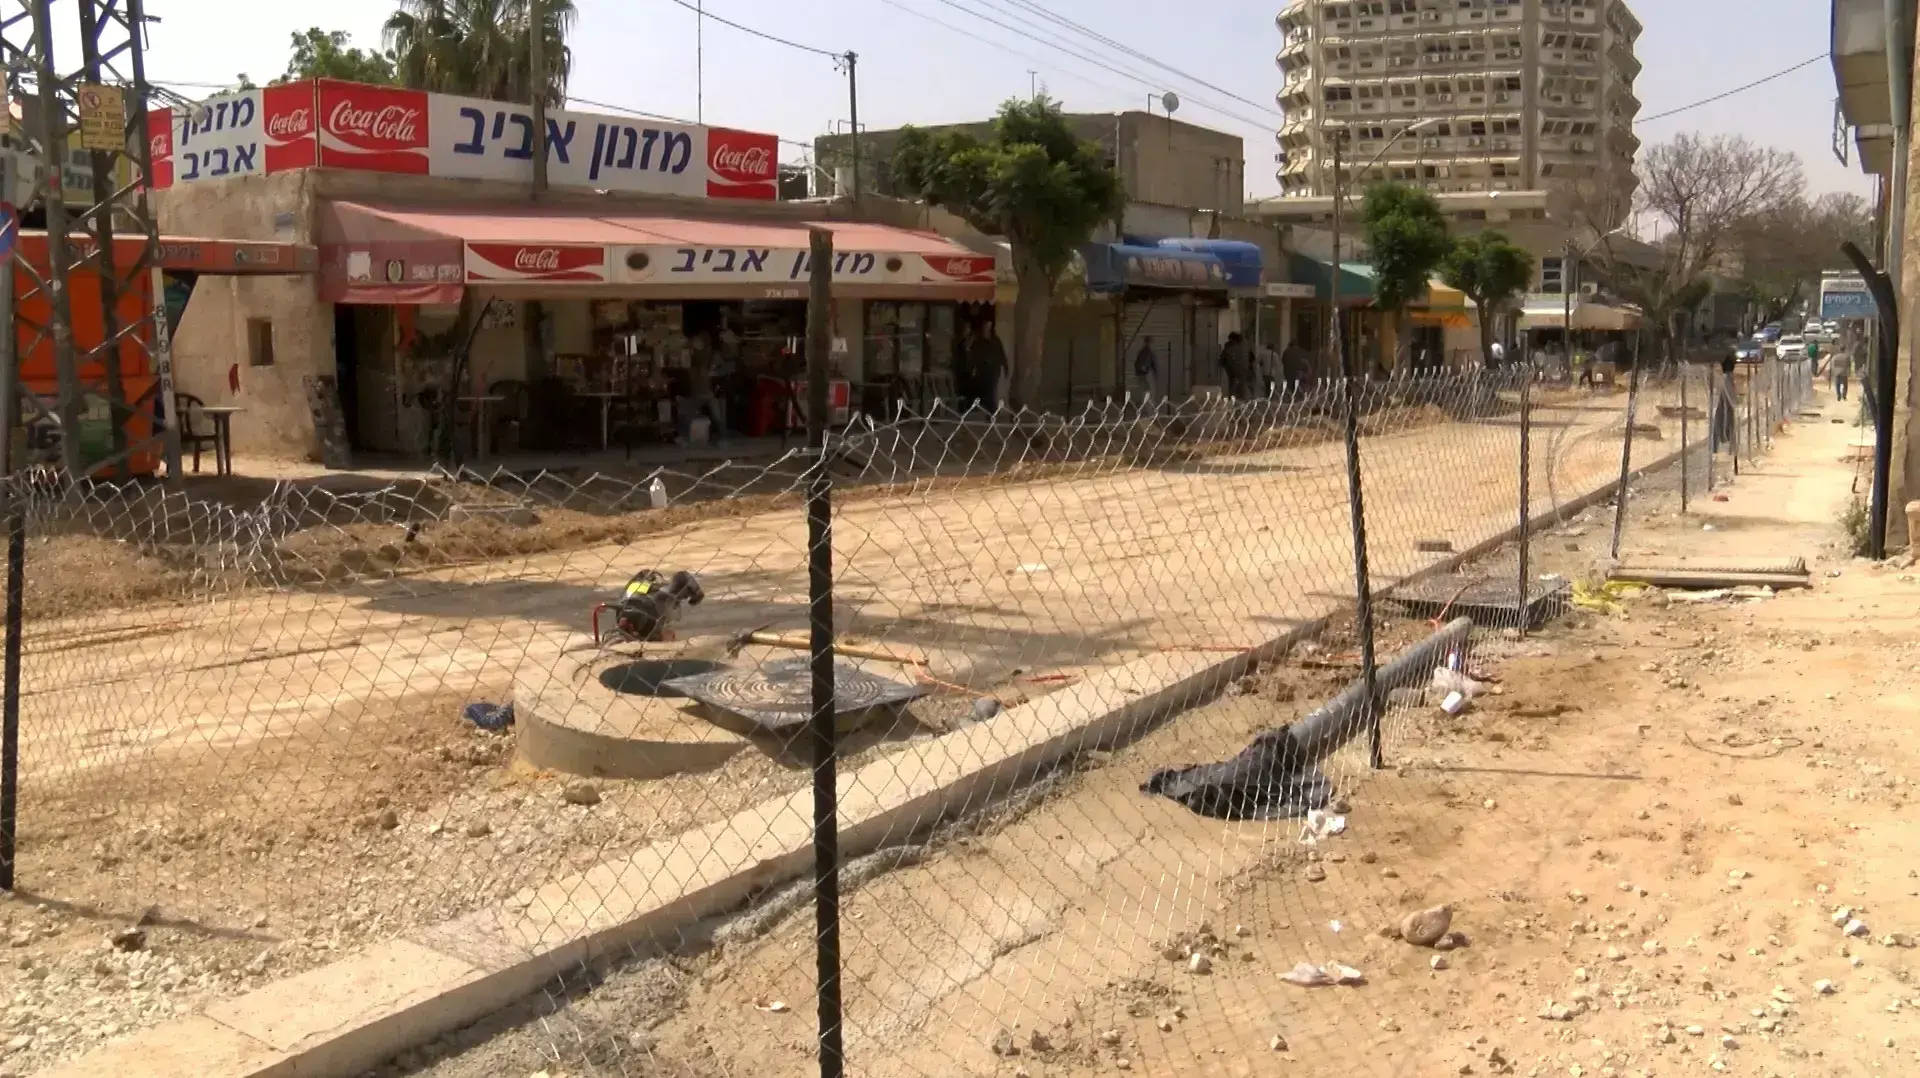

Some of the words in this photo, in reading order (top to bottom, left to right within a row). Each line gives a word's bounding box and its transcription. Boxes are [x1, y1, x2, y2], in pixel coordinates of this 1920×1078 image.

[269, 108, 310, 135] Coca-Cola
[329, 99, 421, 142] Coca-Cola
[453, 107, 576, 164] אביב
[181, 142, 257, 180] אביב
[589, 122, 692, 180] מזנון
[713, 143, 772, 175] Coca-Cola
[671, 248, 770, 272] אביב
